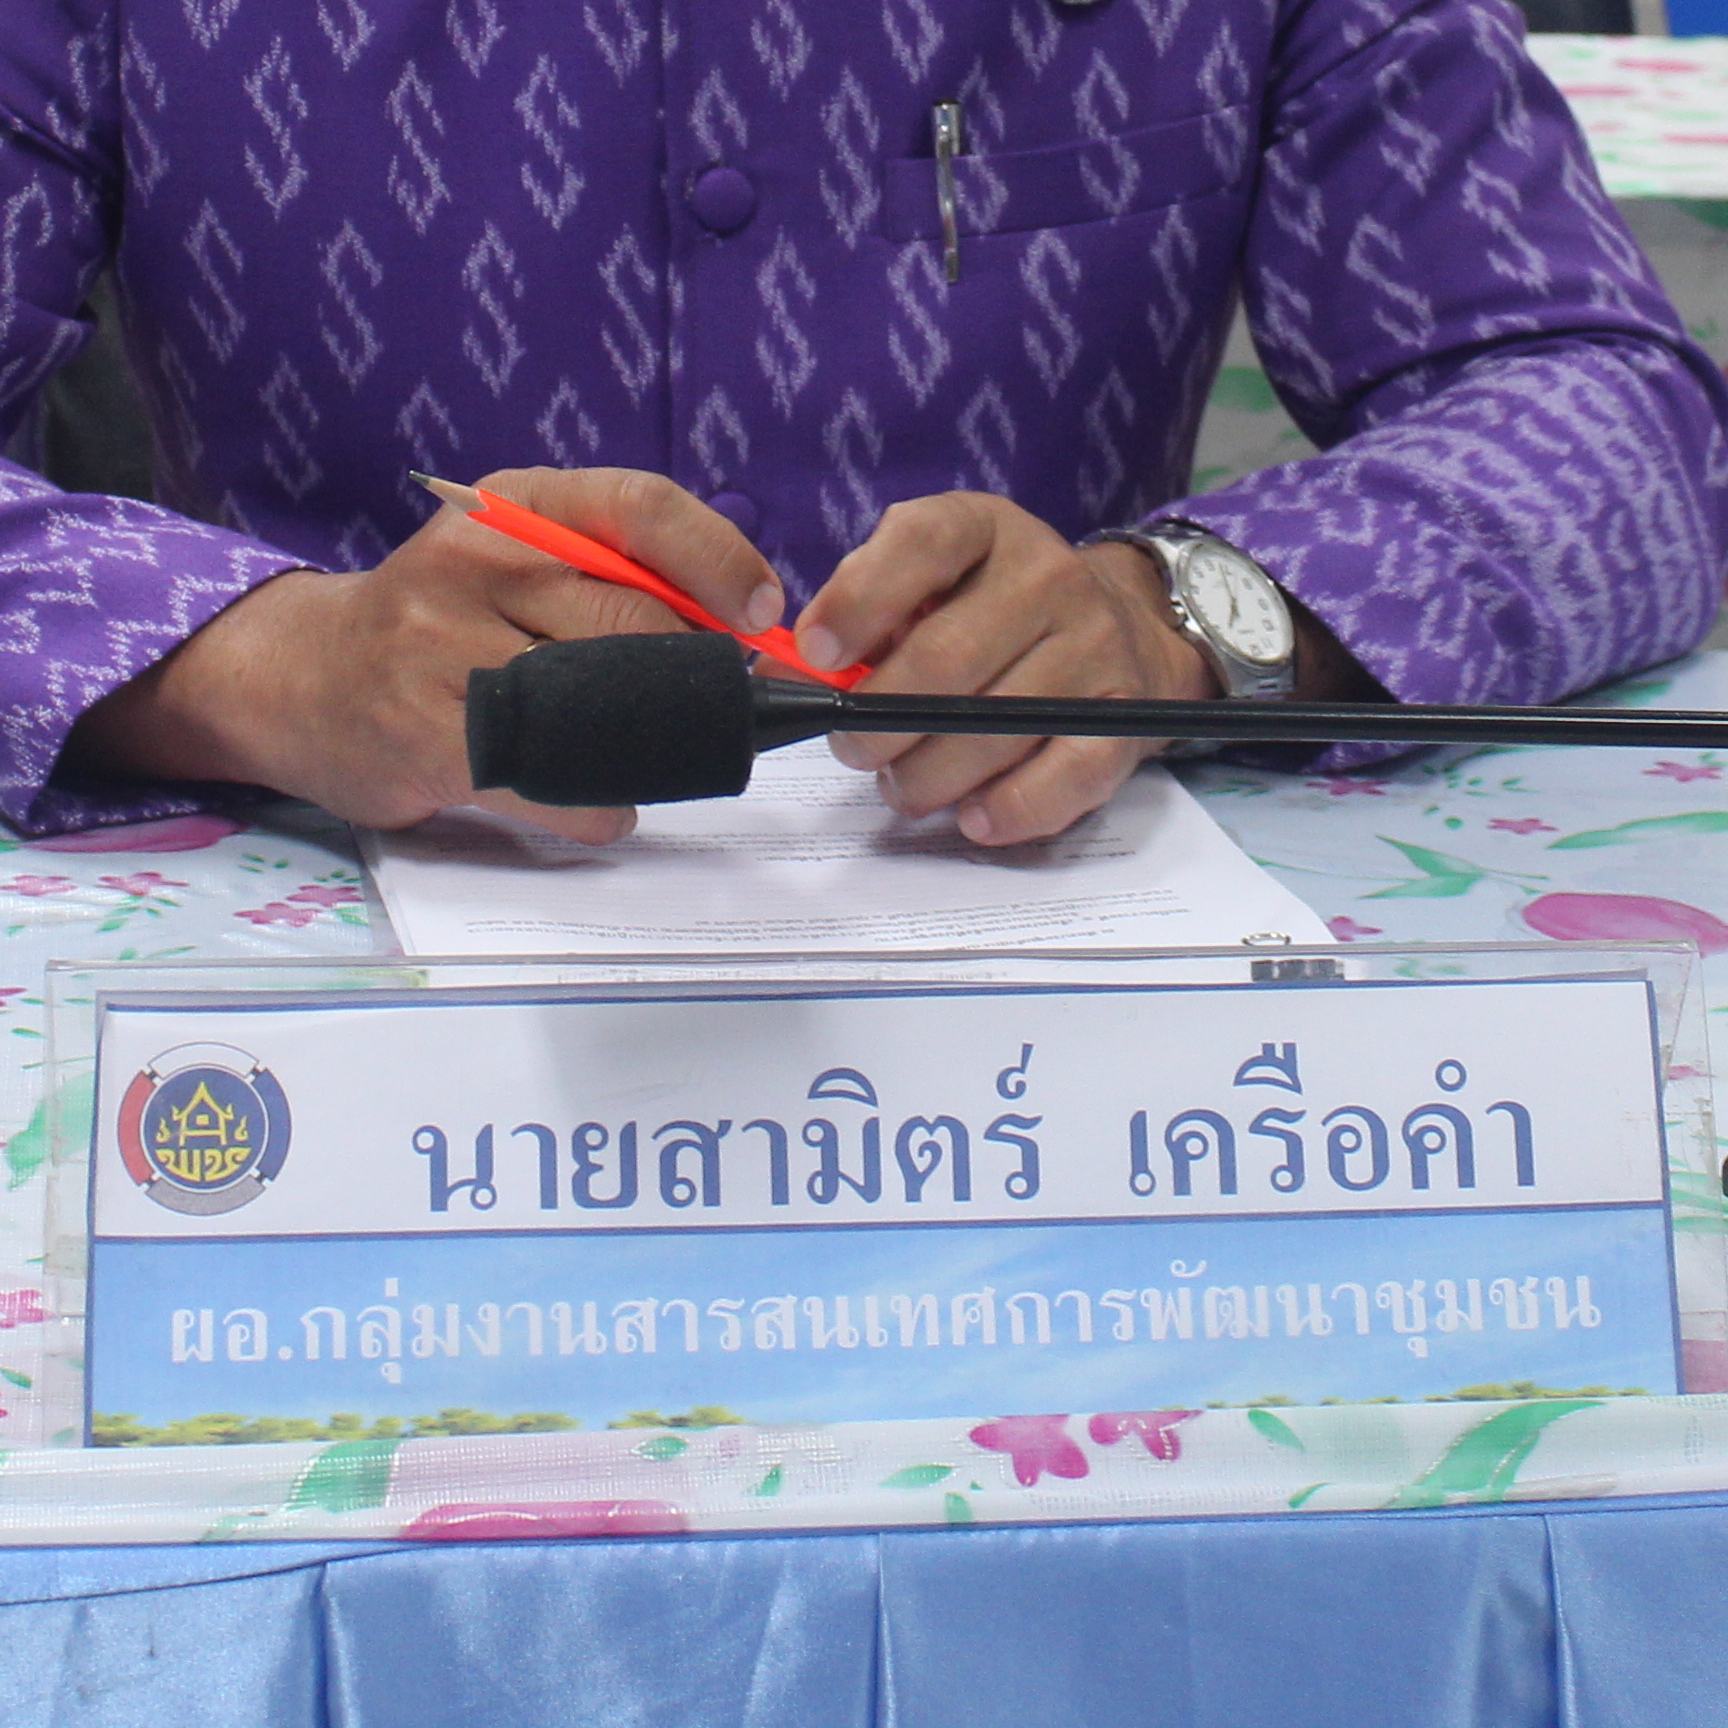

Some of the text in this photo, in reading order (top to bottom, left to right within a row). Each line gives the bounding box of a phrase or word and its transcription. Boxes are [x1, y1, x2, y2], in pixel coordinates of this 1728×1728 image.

[411, 1041, 1536, 1212] นายสามิตร์ เครือคำ
[171, 1258, 1602, 1384] ผอ.กลุ่มงานสารสนเทศการพัฒนาชุมชน
